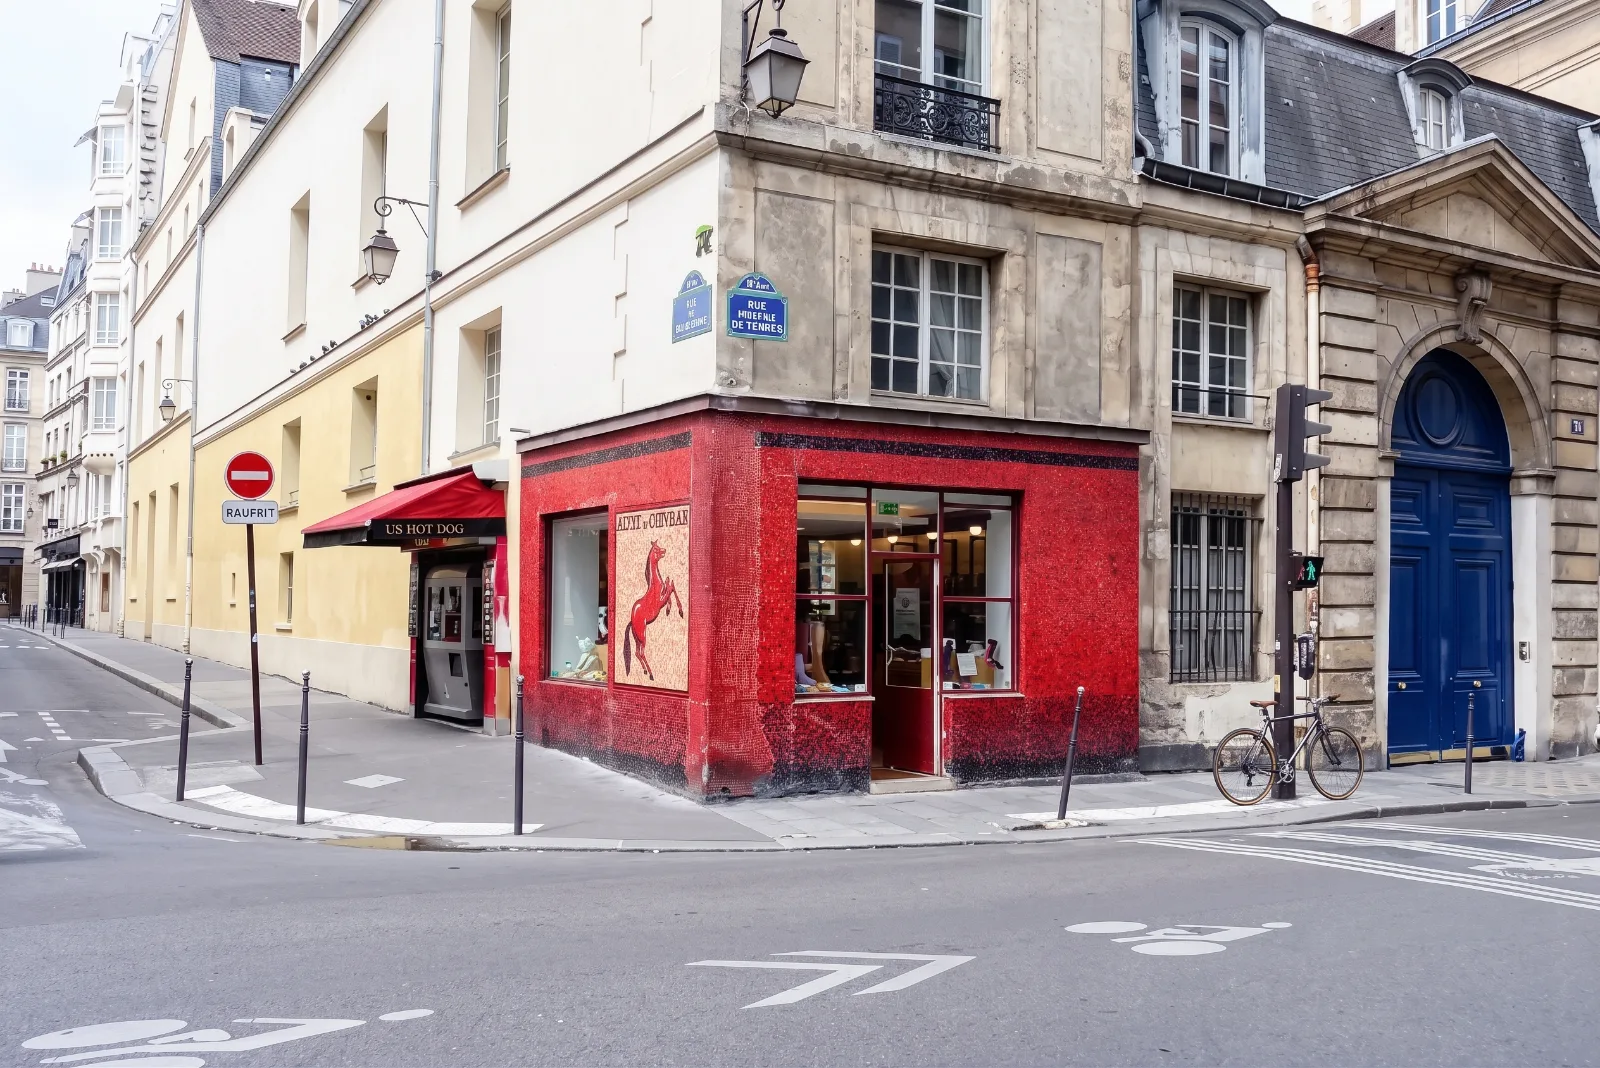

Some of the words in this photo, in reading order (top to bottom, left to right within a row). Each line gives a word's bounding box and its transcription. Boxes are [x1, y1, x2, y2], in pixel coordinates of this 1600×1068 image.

[748, 301, 767, 311] RUE
[731, 320, 744, 330] DE
[226, 508, 275, 518] RAUFRIT
[385, 524, 403, 535] US
[406, 524, 434, 535] HOT
[437, 523, 465, 534] DOG
